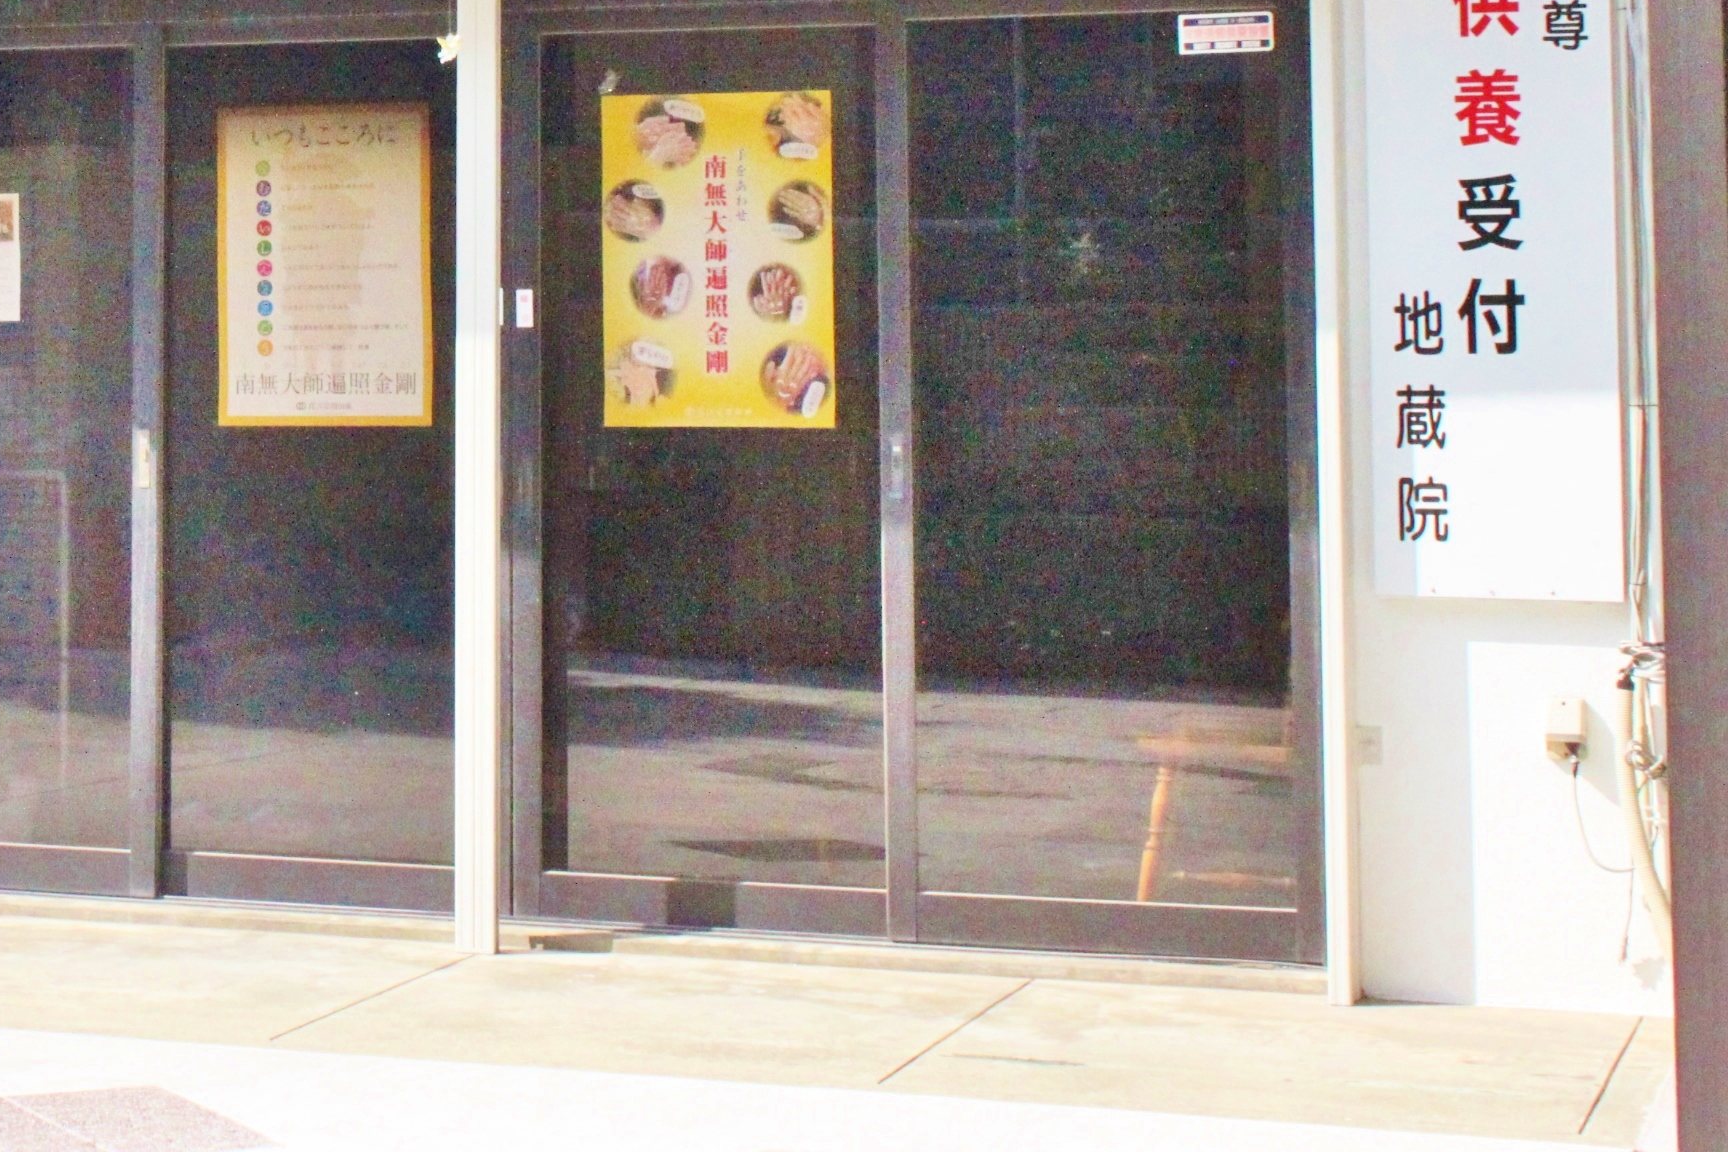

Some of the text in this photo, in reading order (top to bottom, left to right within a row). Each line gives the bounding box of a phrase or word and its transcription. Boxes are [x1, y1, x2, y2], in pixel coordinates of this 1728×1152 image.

[250, 122, 396, 148] いつもこころに
[1394, 291, 1448, 541] 地蔵院
